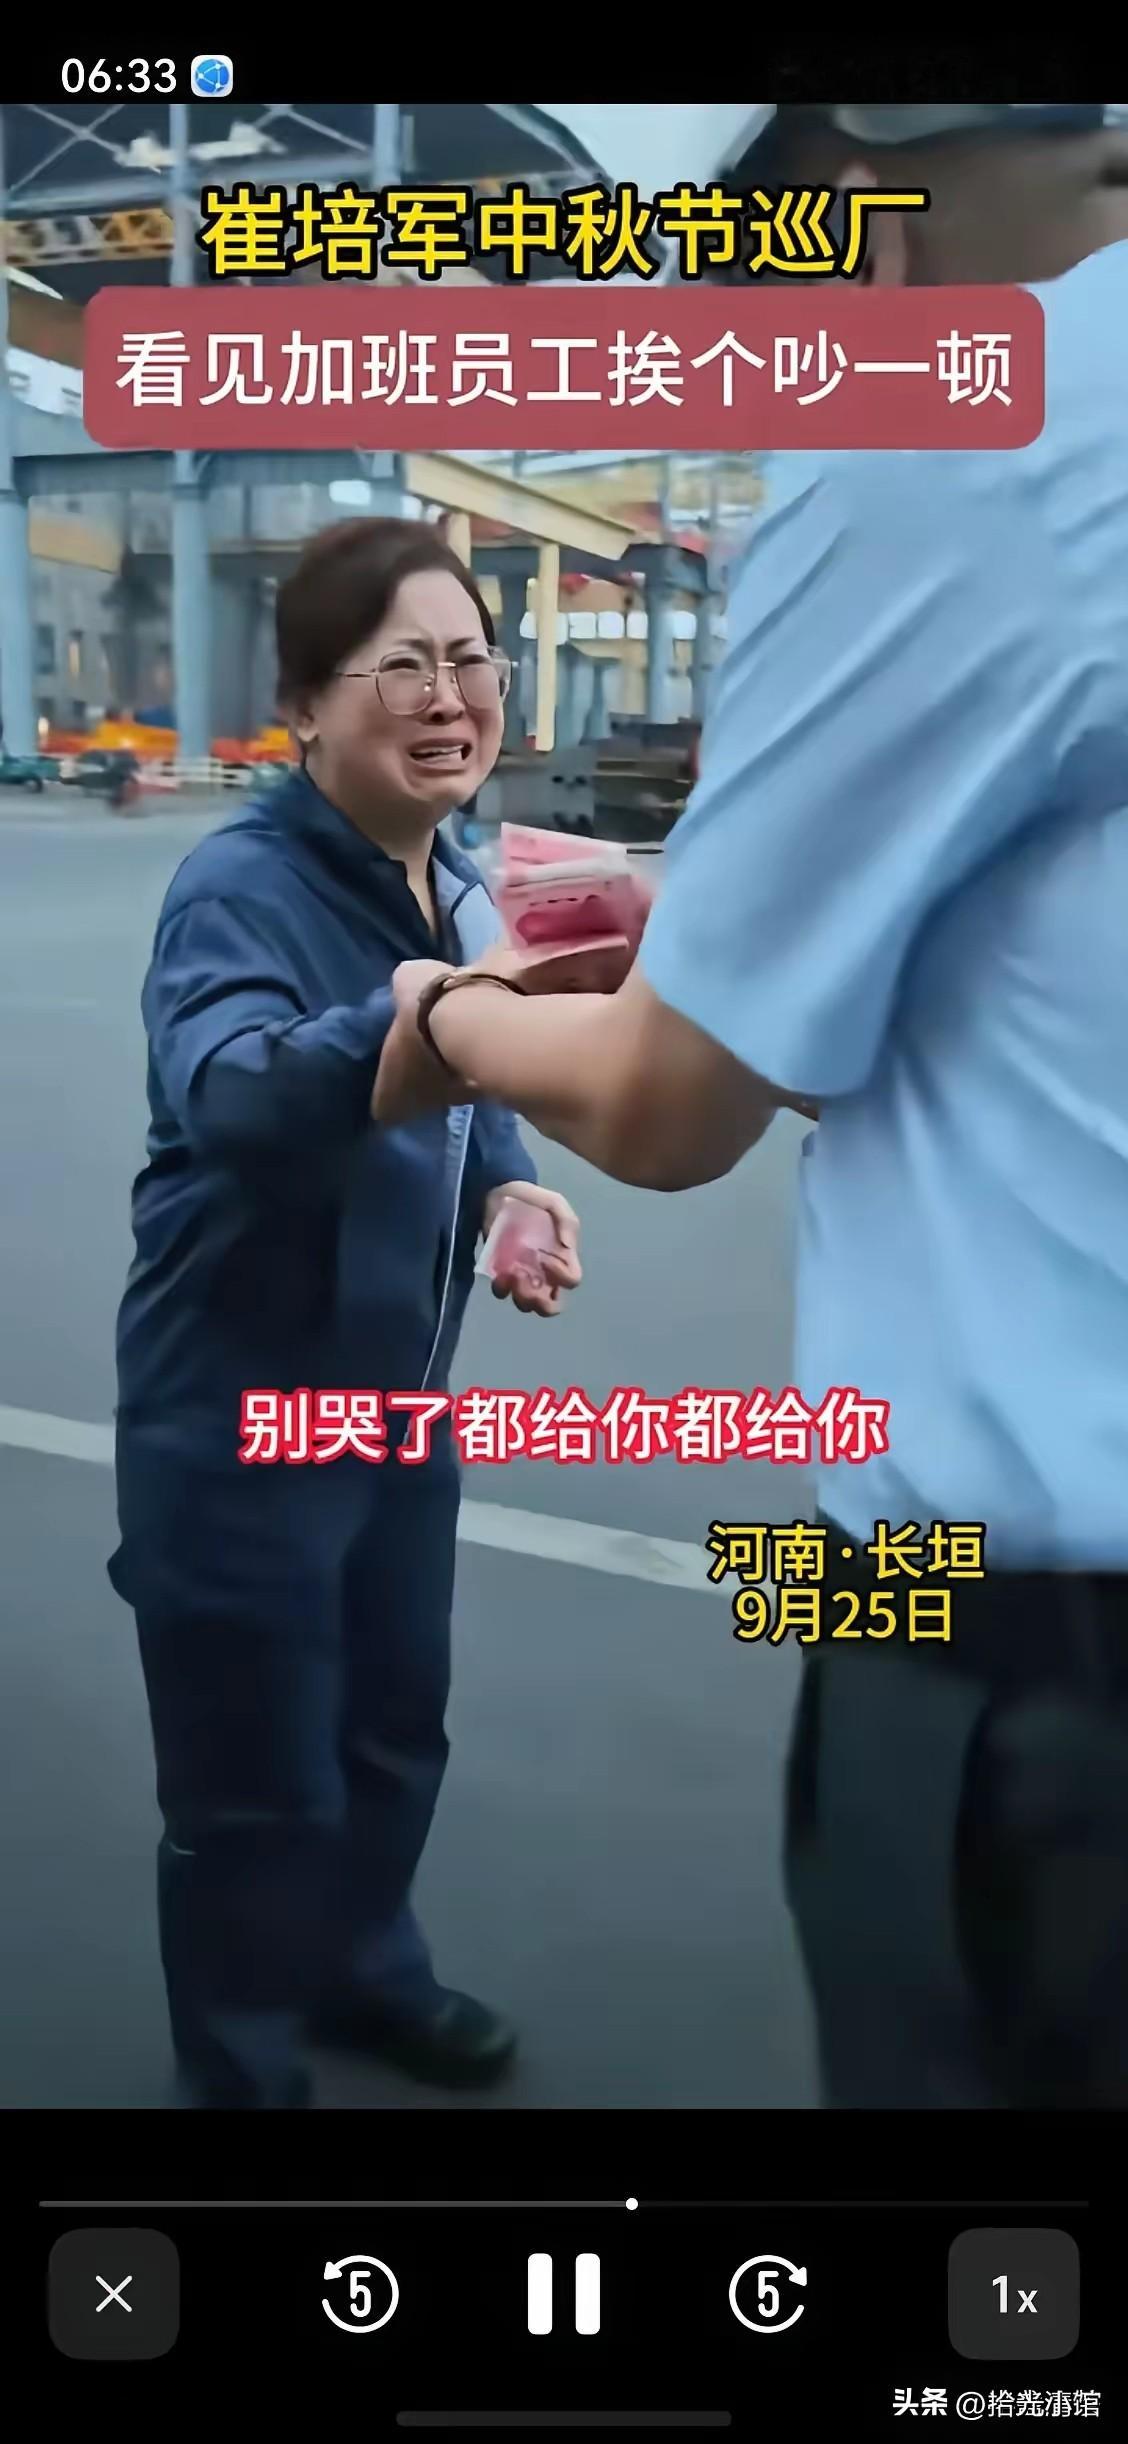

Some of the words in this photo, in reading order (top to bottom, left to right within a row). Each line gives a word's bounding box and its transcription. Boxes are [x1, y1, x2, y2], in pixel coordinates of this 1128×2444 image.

[62, 58, 177, 93] 06:33
[350, 2270, 371, 2318] 5
[757, 2270, 779, 2318] 5
[992, 2275, 1038, 2314] 1x
